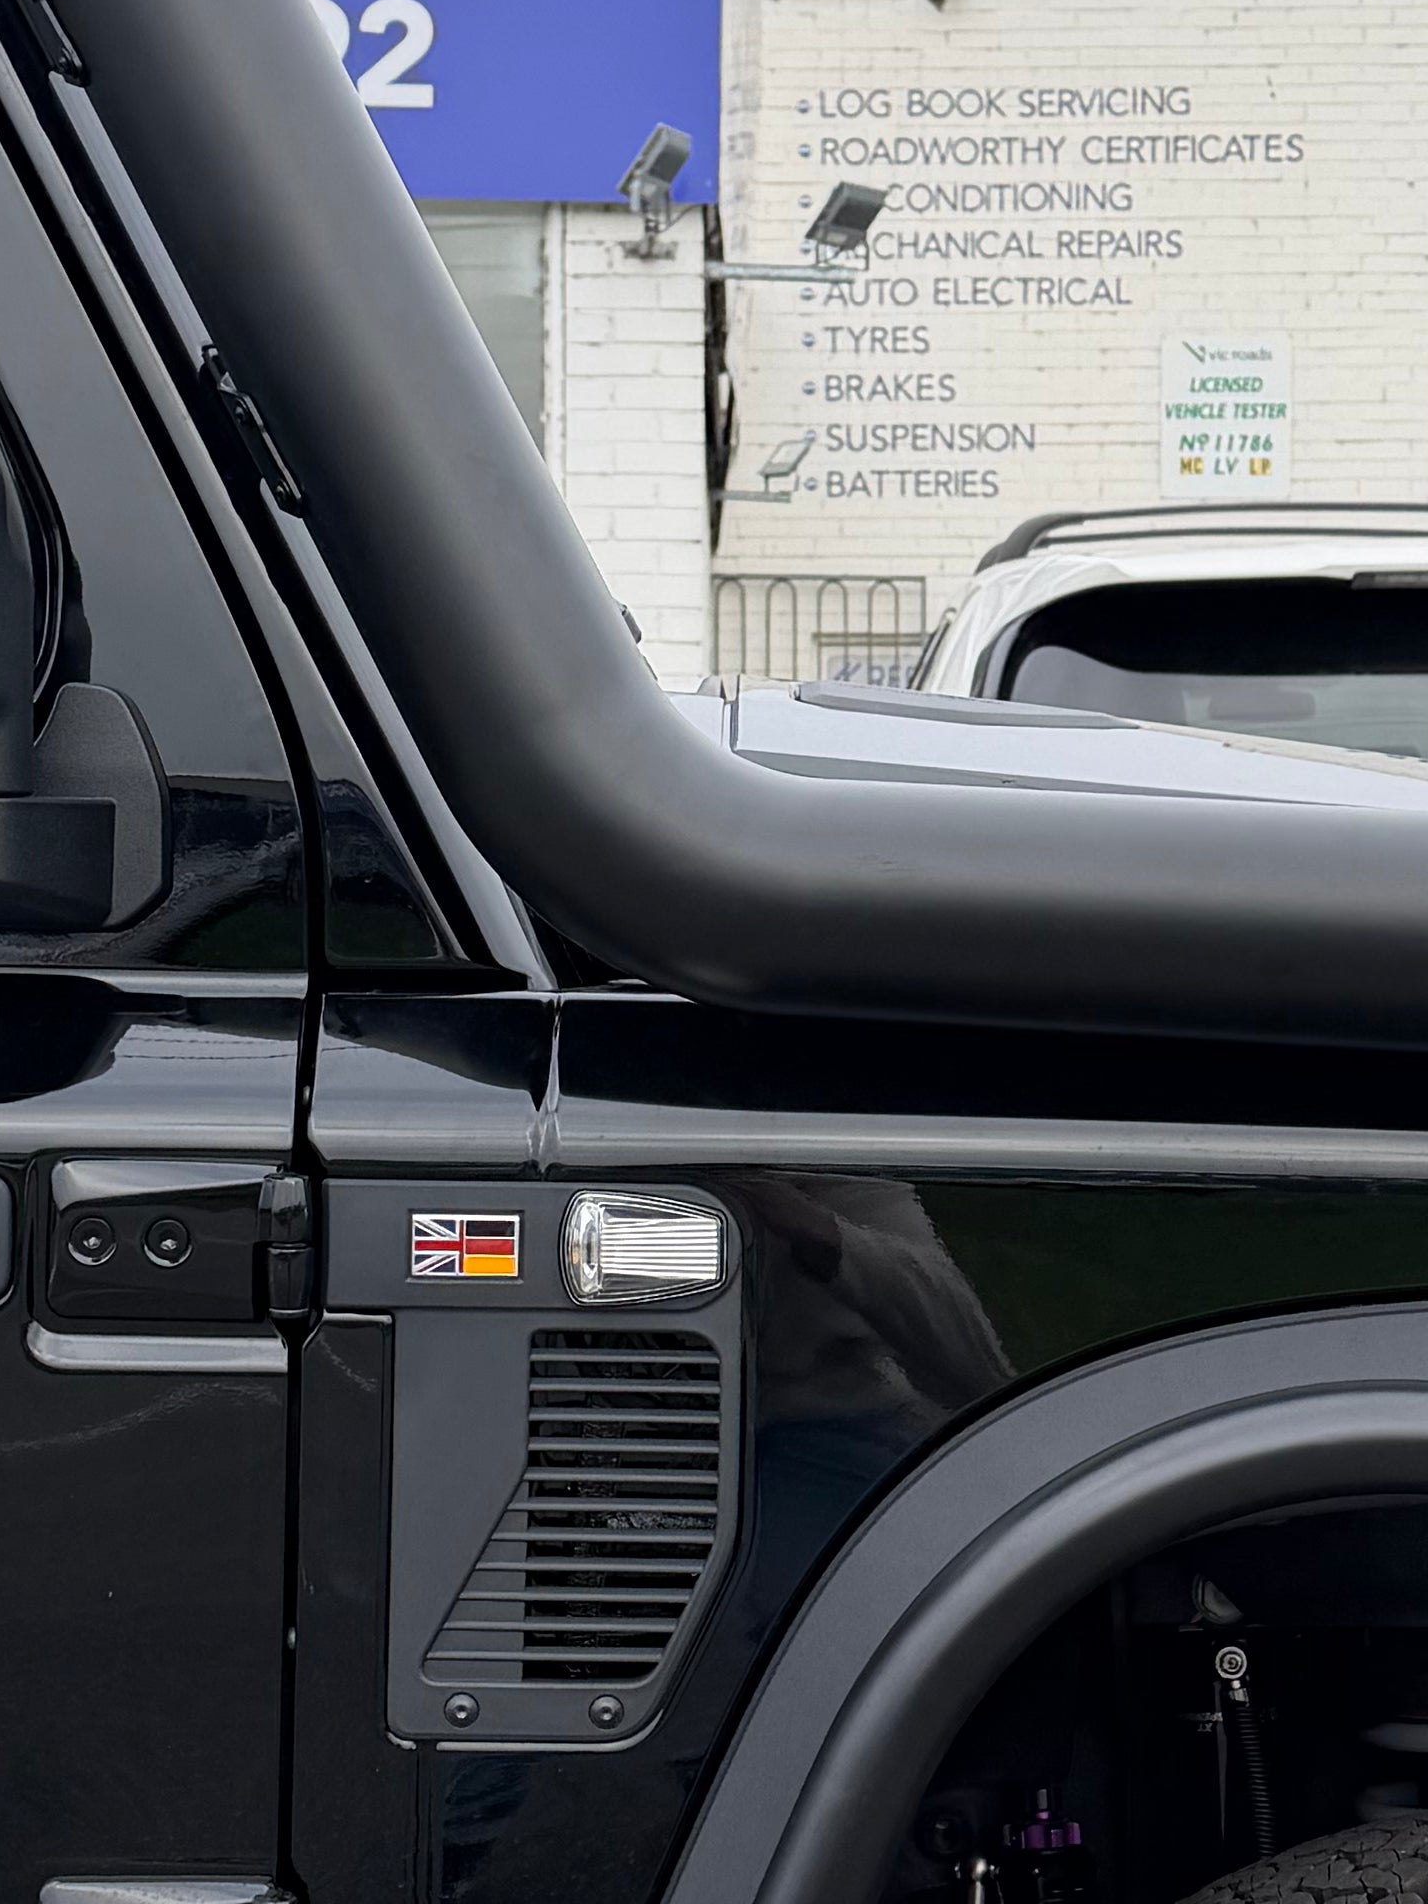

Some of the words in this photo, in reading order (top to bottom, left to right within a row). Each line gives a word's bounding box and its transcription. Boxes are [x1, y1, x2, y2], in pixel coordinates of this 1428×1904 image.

[818, 88, 891, 119] LOG
[906, 87, 1006, 118] BOOK
[1018, 86, 1191, 117] SERVICING
[820, 136, 1067, 167] ROADWORTHY
[1081, 133, 1304, 164] CERTIFICATES
[883, 183, 1133, 213] CONDITIONING
[830, 232, 1043, 260] CHANICAL
[1056, 230, 1183, 259] REPAIRS
[823, 278, 918, 308] AUTO
[933, 277, 1133, 307] ELECTRICAL
[823, 326, 930, 355] TYRES
[824, 374, 956, 403] BRAKES
[1189, 376, 1264, 393] LICENSED
[1165, 402, 1227, 420] VEHICLE
[1233, 402, 1288, 420] TESTER
[826, 423, 1036, 452] SUSPENSION
[1213, 457, 1239, 475] LV
[826, 470, 1000, 498] BATTERIES
